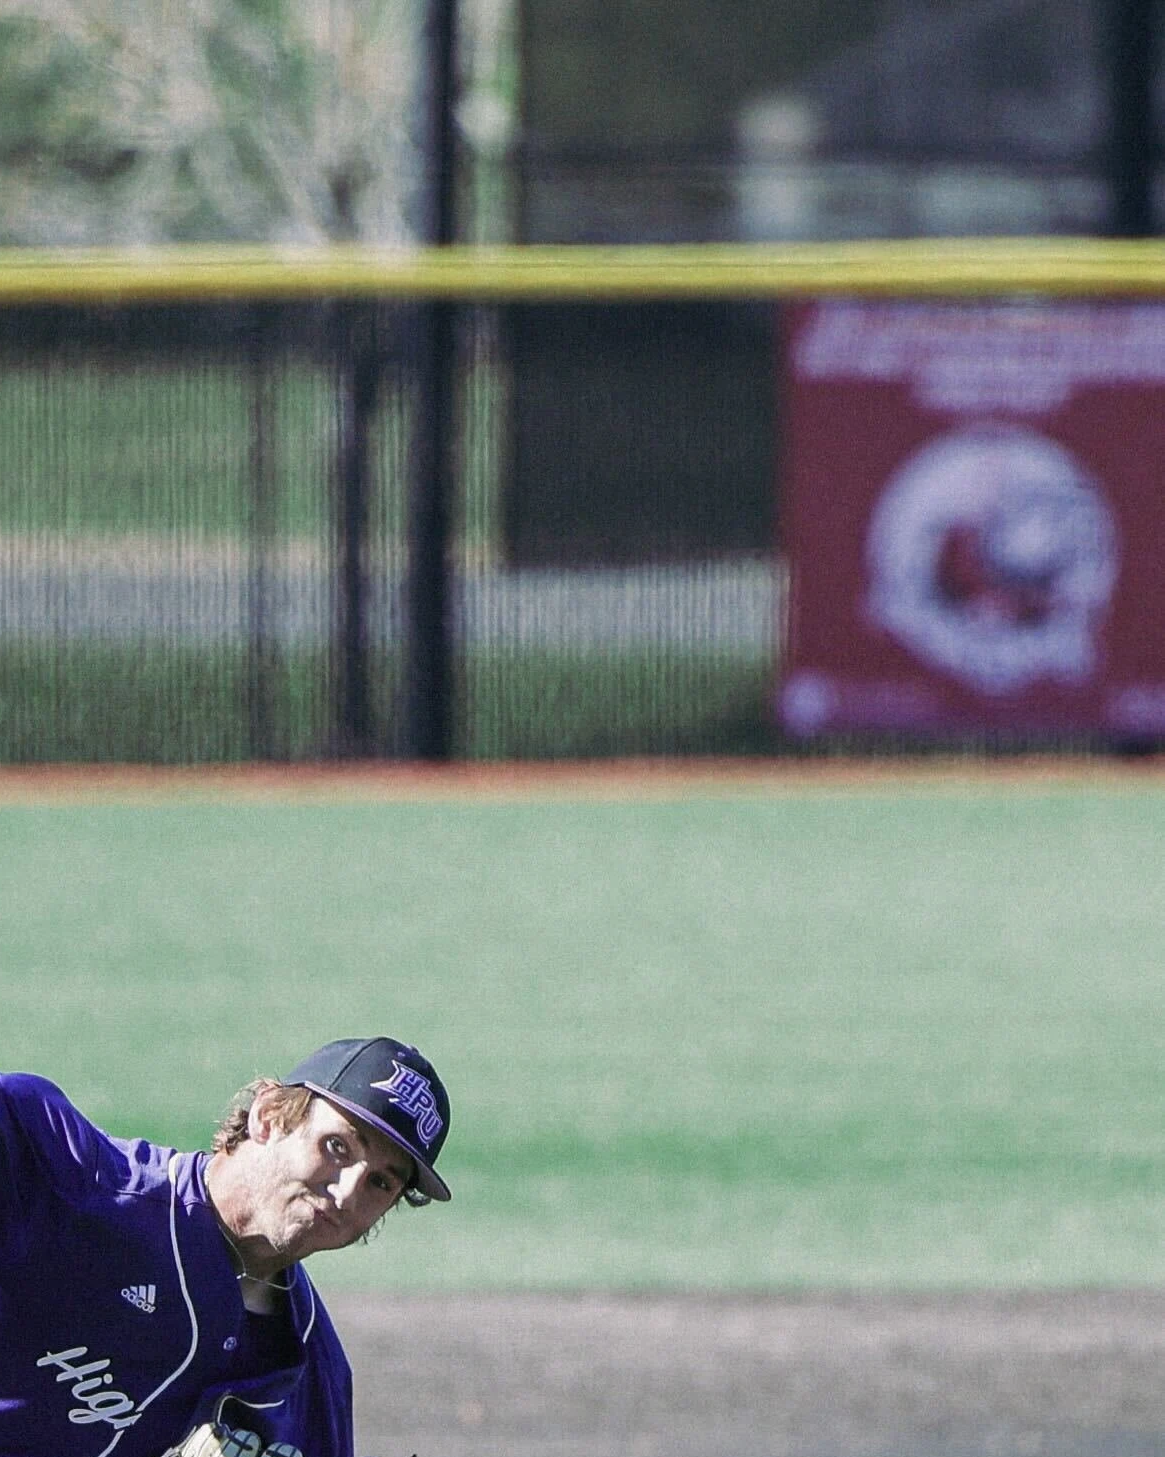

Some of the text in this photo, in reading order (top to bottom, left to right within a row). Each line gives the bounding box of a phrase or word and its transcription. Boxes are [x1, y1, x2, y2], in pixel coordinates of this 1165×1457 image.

[382, 1061, 443, 1144] HPU
[120, 1287, 156, 1314] adidas
[36, 1346, 142, 1429] Hig
